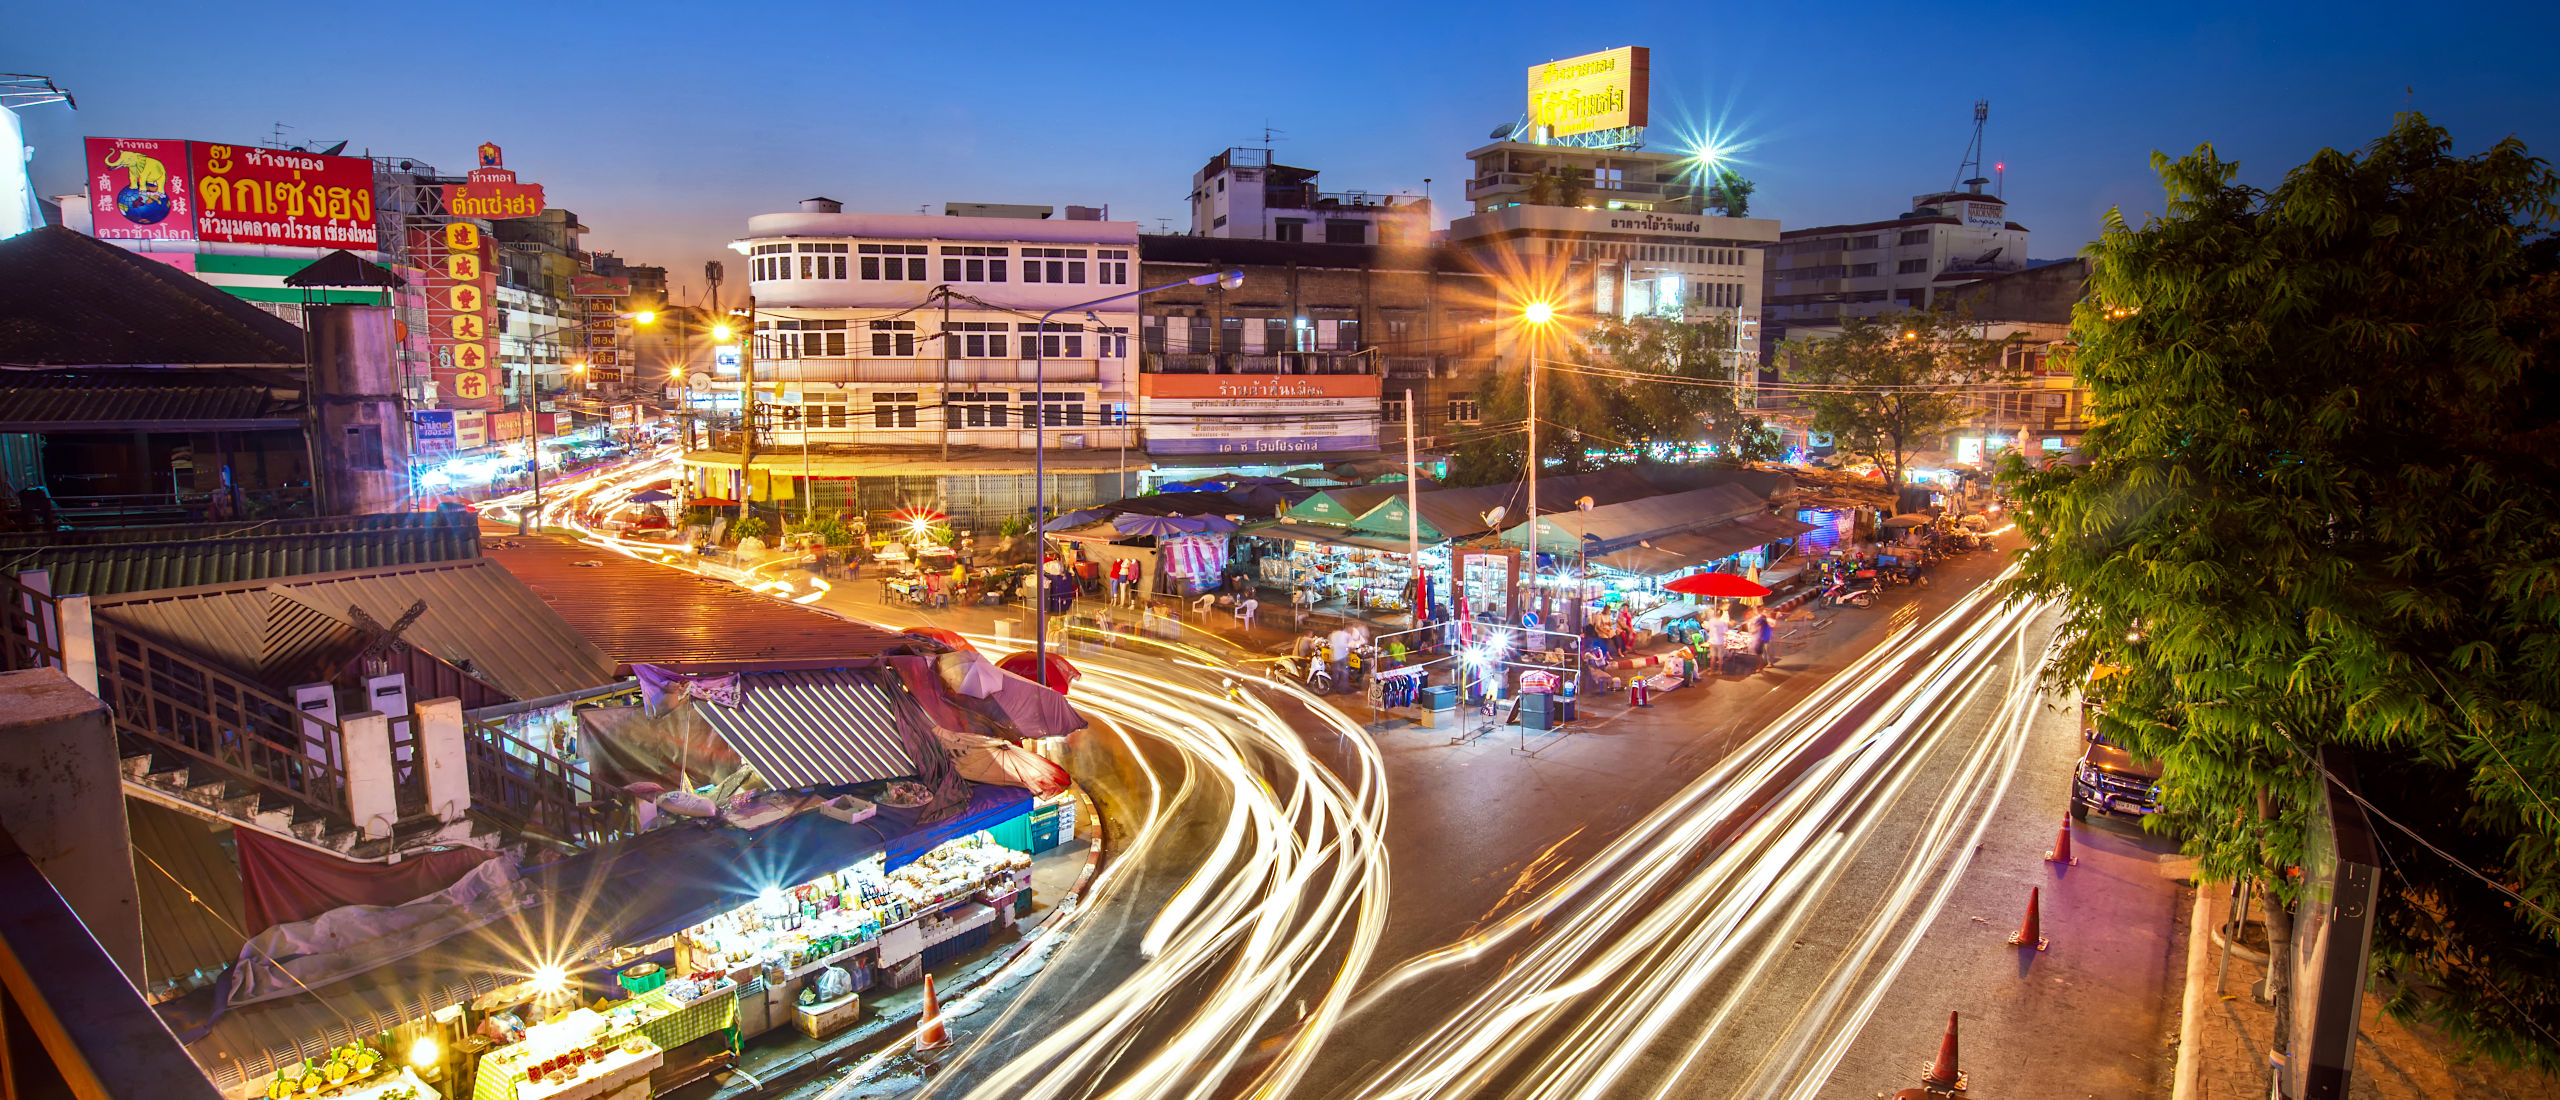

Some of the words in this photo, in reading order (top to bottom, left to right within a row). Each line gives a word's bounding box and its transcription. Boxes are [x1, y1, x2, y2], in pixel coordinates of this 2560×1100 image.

[115, 139, 159, 150] ห้างทอง
[245, 148, 324, 172] ห้างทอง
[199, 144, 372, 222] ตั๊กเซ่งฮง
[471, 171, 511, 183] ห้างทอง
[452, 187, 536, 215] ตั๊กเซ่งฮง
[98, 223, 191, 240] ตราช้างโลก
[199, 211, 322, 243] หัวมุมตลาดวโรรส
[323, 219, 377, 244] เชียงใหม่
[592, 299, 613, 312] ห้าง
[593, 336, 615, 346] ทอง
